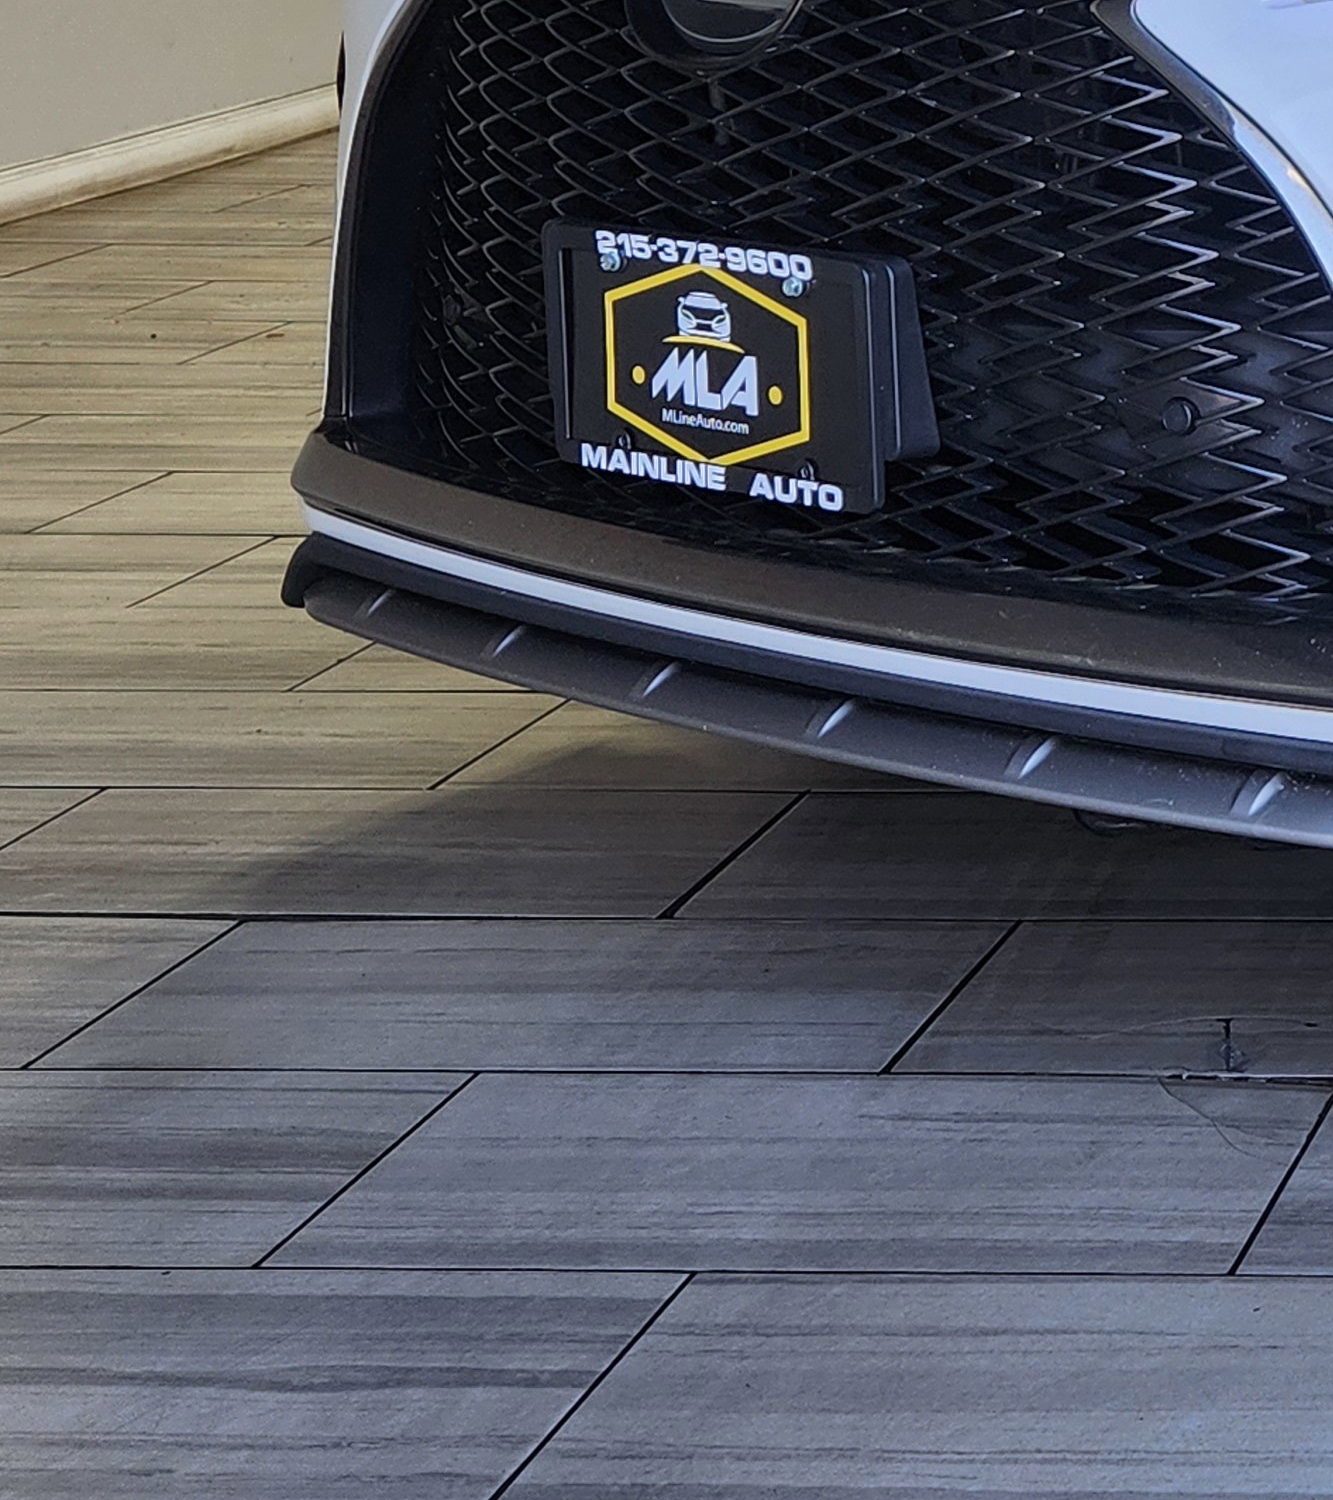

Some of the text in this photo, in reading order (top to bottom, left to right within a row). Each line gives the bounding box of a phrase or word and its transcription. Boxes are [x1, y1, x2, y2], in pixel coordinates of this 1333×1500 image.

[595, 229, 813, 280] 215-372-9600
[652, 347, 759, 417] MLA
[661, 408, 750, 436] MLineAuto.com
[580, 442, 844, 513] MAINLINE AUTO
